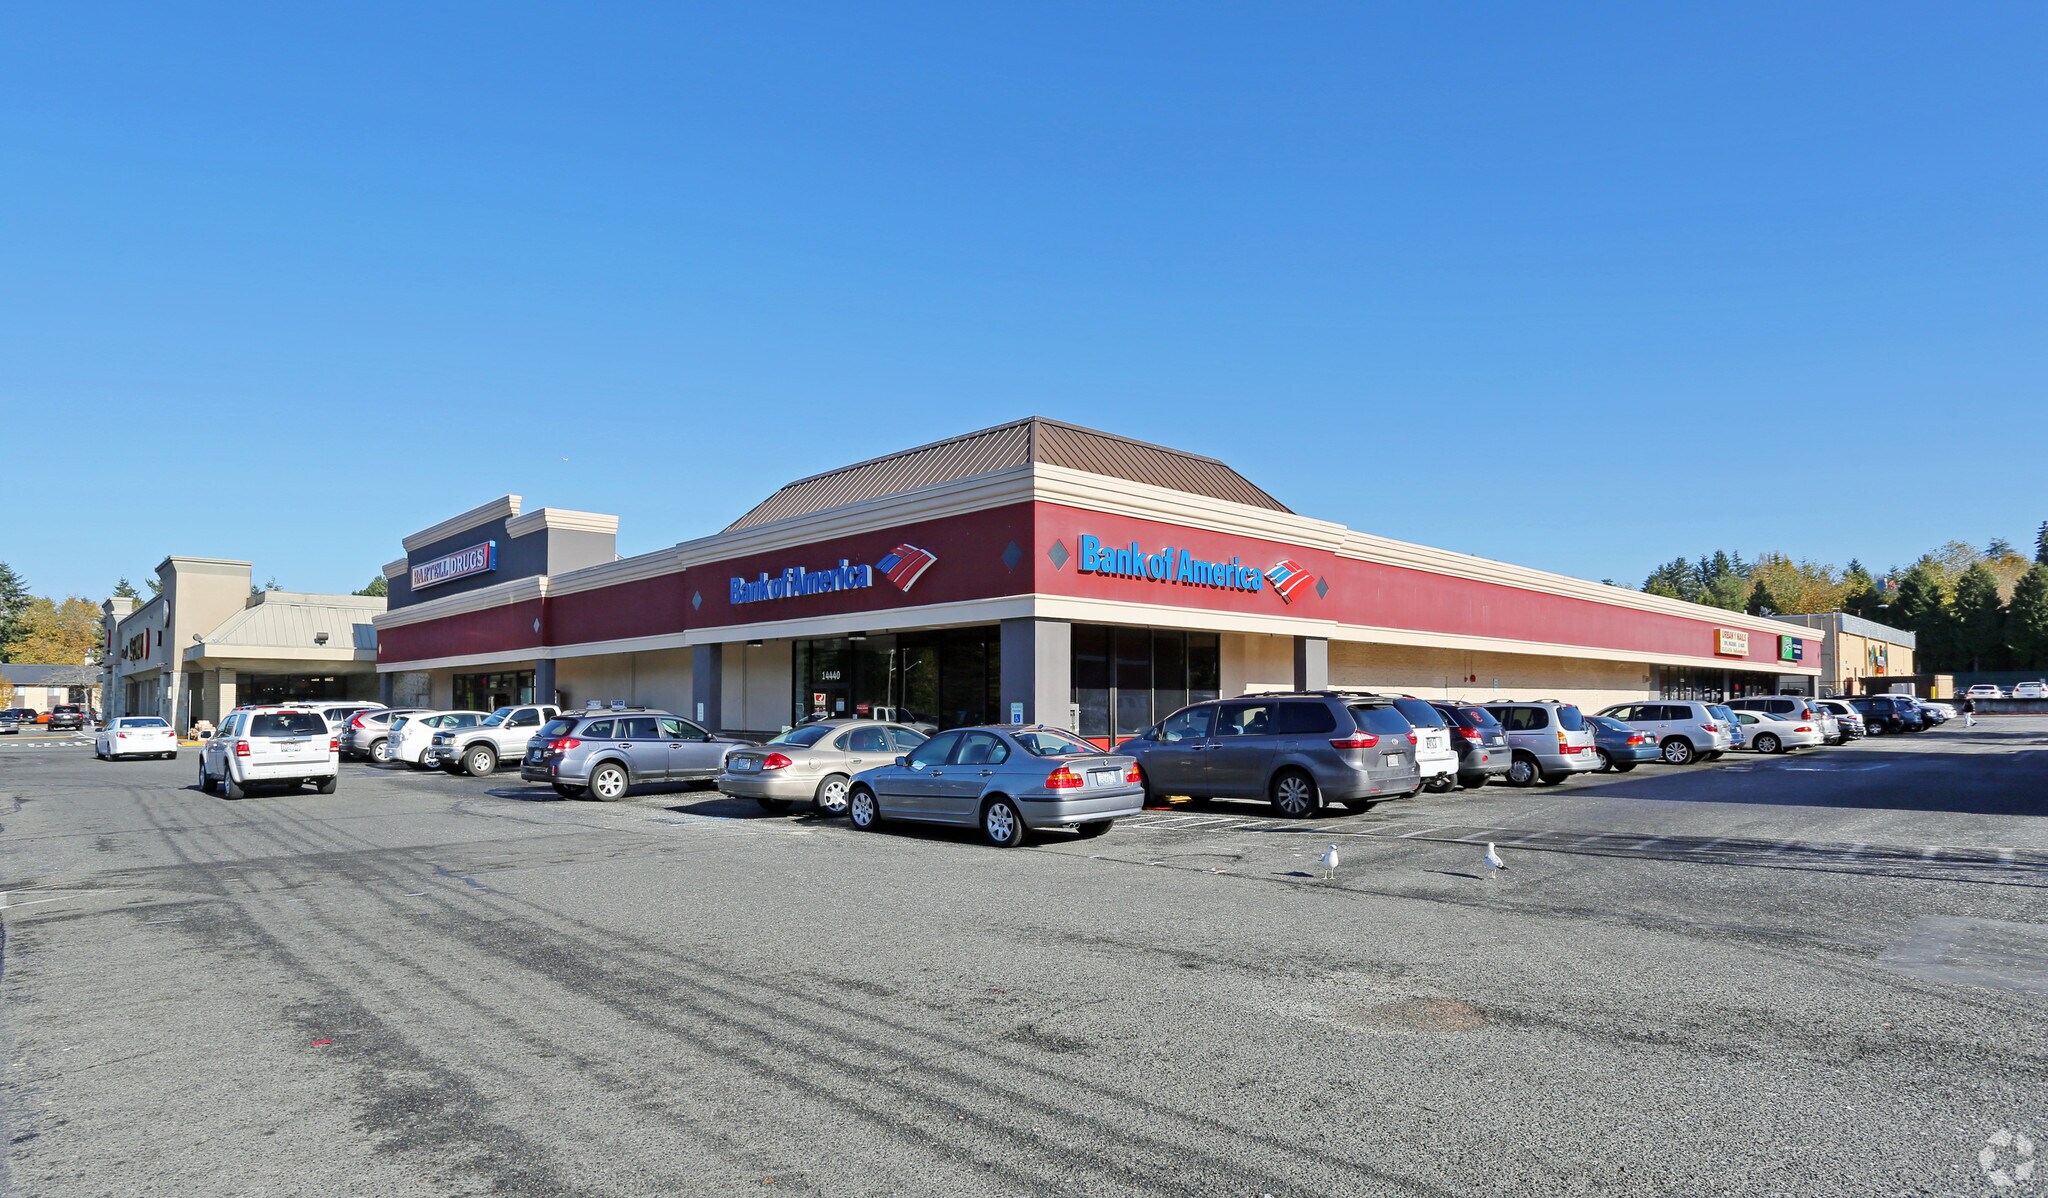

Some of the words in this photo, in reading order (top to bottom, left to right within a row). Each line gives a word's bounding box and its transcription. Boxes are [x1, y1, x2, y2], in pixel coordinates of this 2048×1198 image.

[414, 560, 449, 585] BARTELL
[450, 547, 486, 573] DRUGS
[730, 572, 769, 604] Bank
[770, 567, 792, 598] of
[790, 559, 873, 596] America
[1078, 533, 1147, 578] Bank
[1147, 546, 1175, 581] of
[1175, 549, 1263, 591] America
[821, 670, 841, 681] 14440
